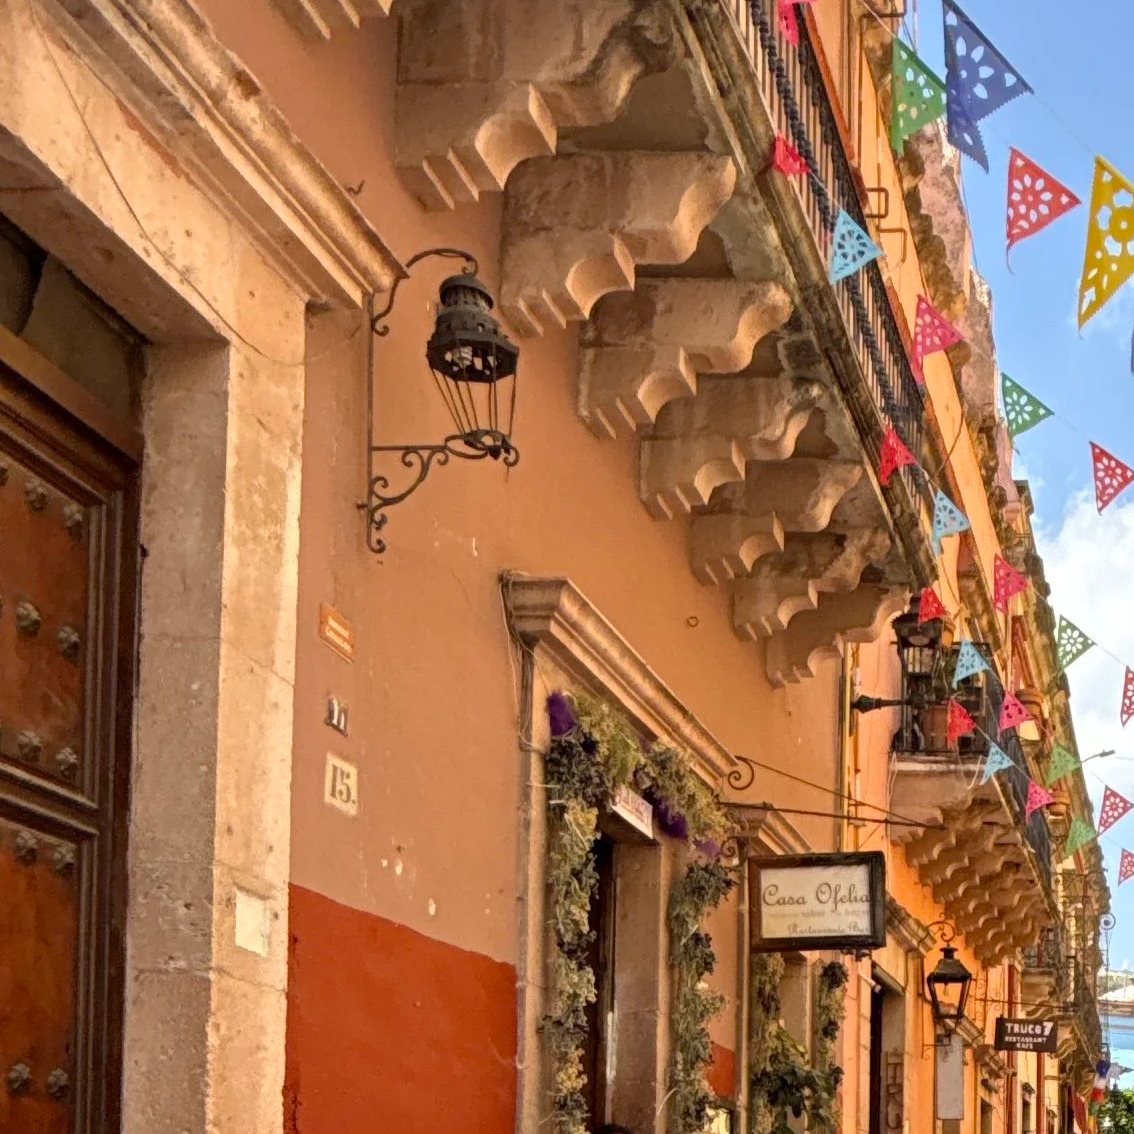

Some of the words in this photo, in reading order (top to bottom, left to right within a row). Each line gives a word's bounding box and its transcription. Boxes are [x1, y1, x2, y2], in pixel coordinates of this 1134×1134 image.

[762, 884, 806, 906] Casa
[816, 881, 871, 912] Ofelia
[1005, 1022, 1042, 1034] TRUCO
[1043, 1021, 1054, 1036] 7
